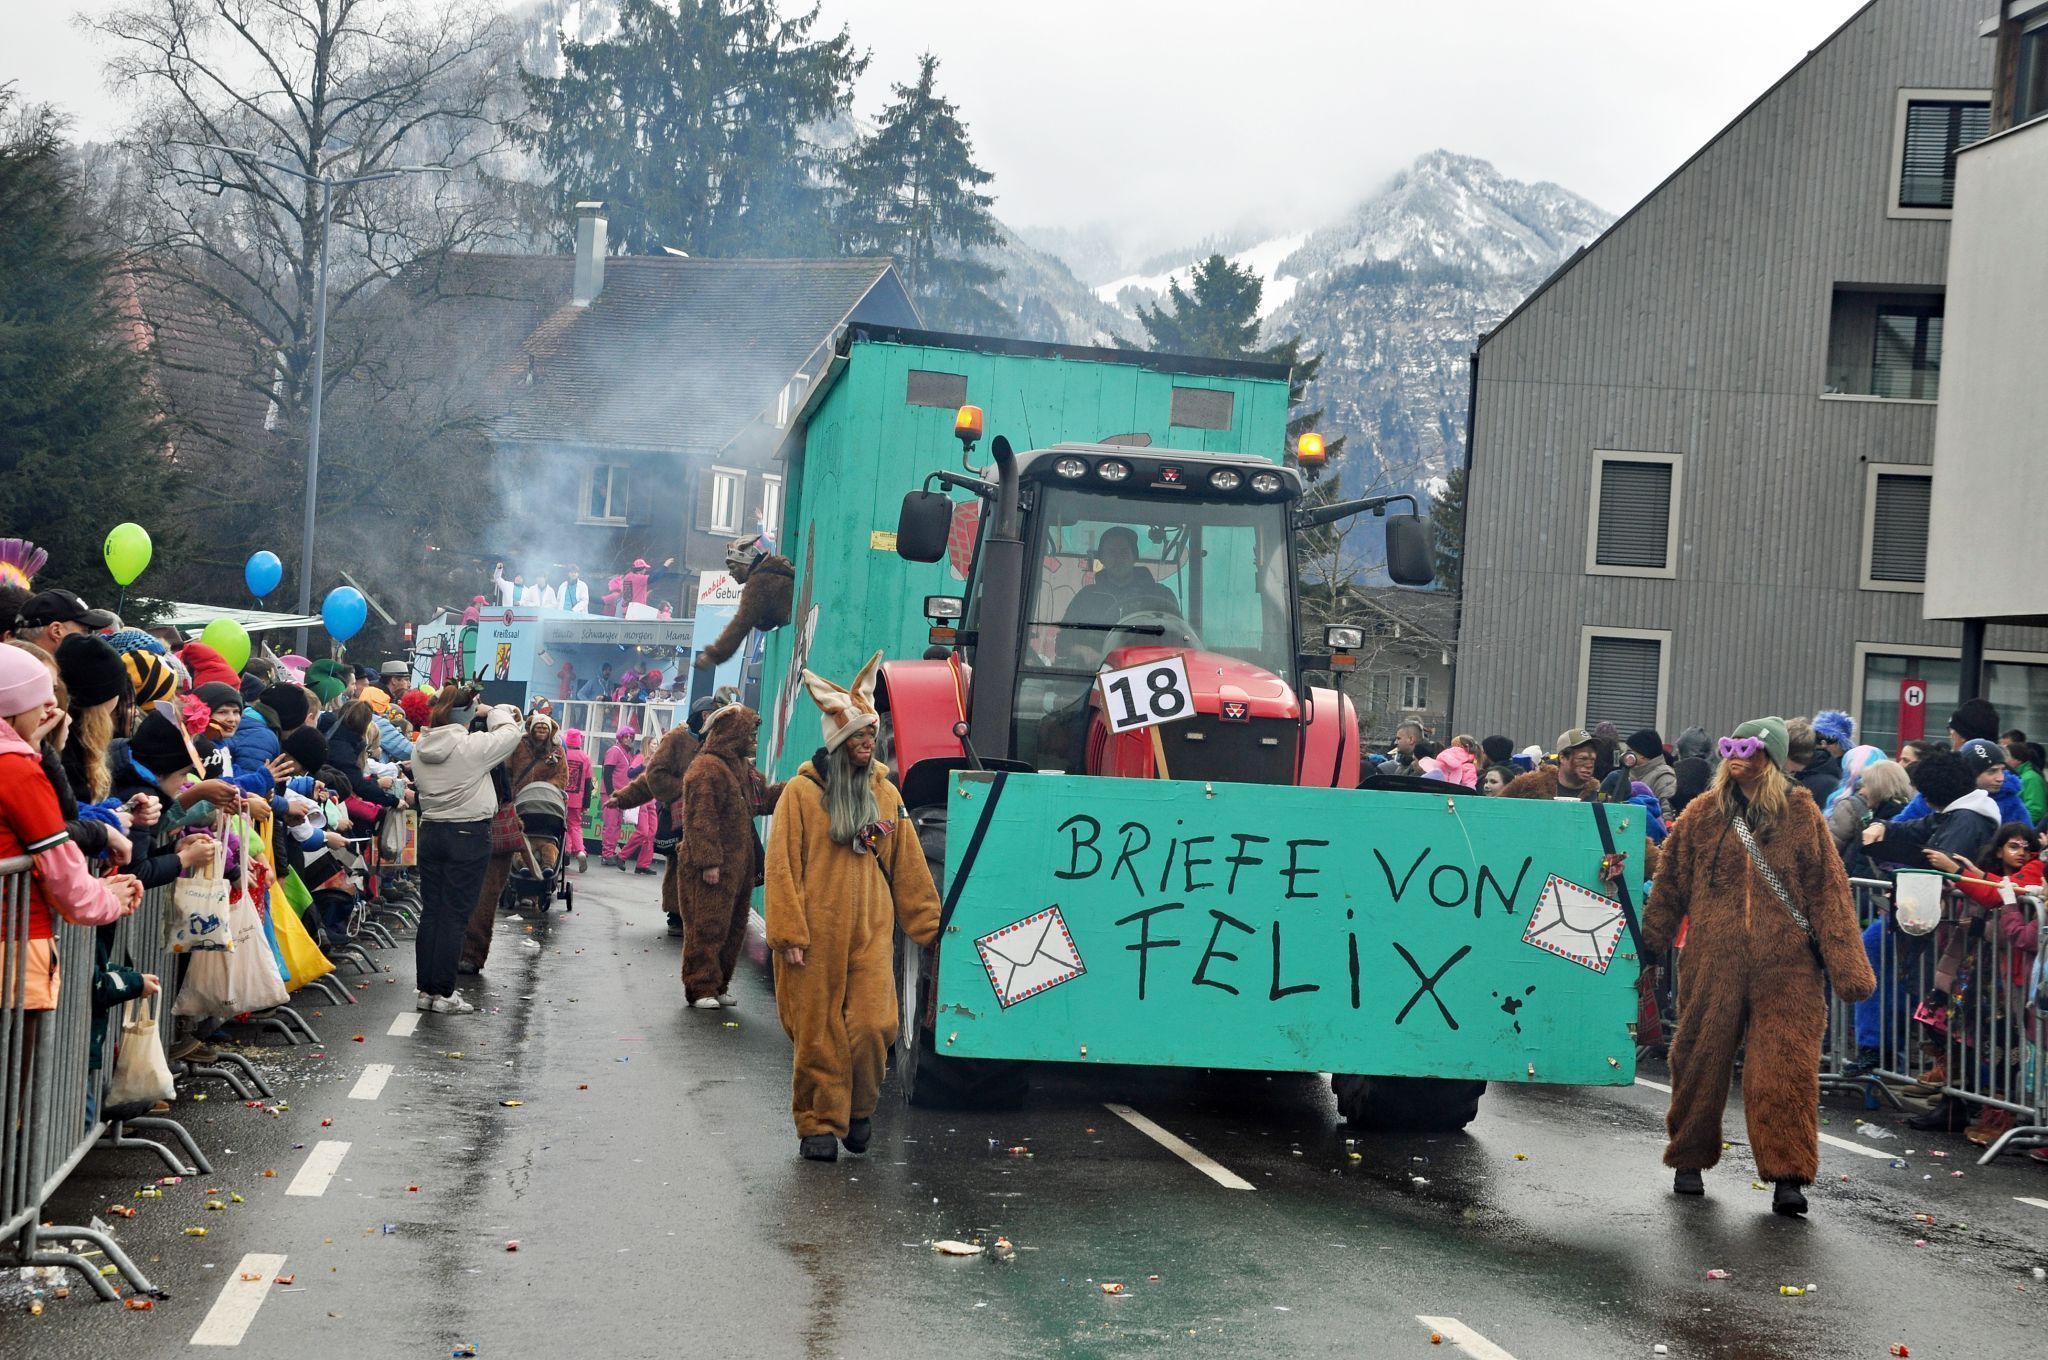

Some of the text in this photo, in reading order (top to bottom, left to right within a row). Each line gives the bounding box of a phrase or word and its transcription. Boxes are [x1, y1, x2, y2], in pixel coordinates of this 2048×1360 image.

[700, 574, 727, 601] mobile
[715, 586, 742, 599] Gebur
[581, 628, 619, 642] Schwanger
[623, 630, 654, 643] morgen
[665, 629, 692, 641] Mama
[1109, 667, 1185, 728] 18
[1909, 690, 1920, 703] H
[1373, 847, 1533, 919] VON
